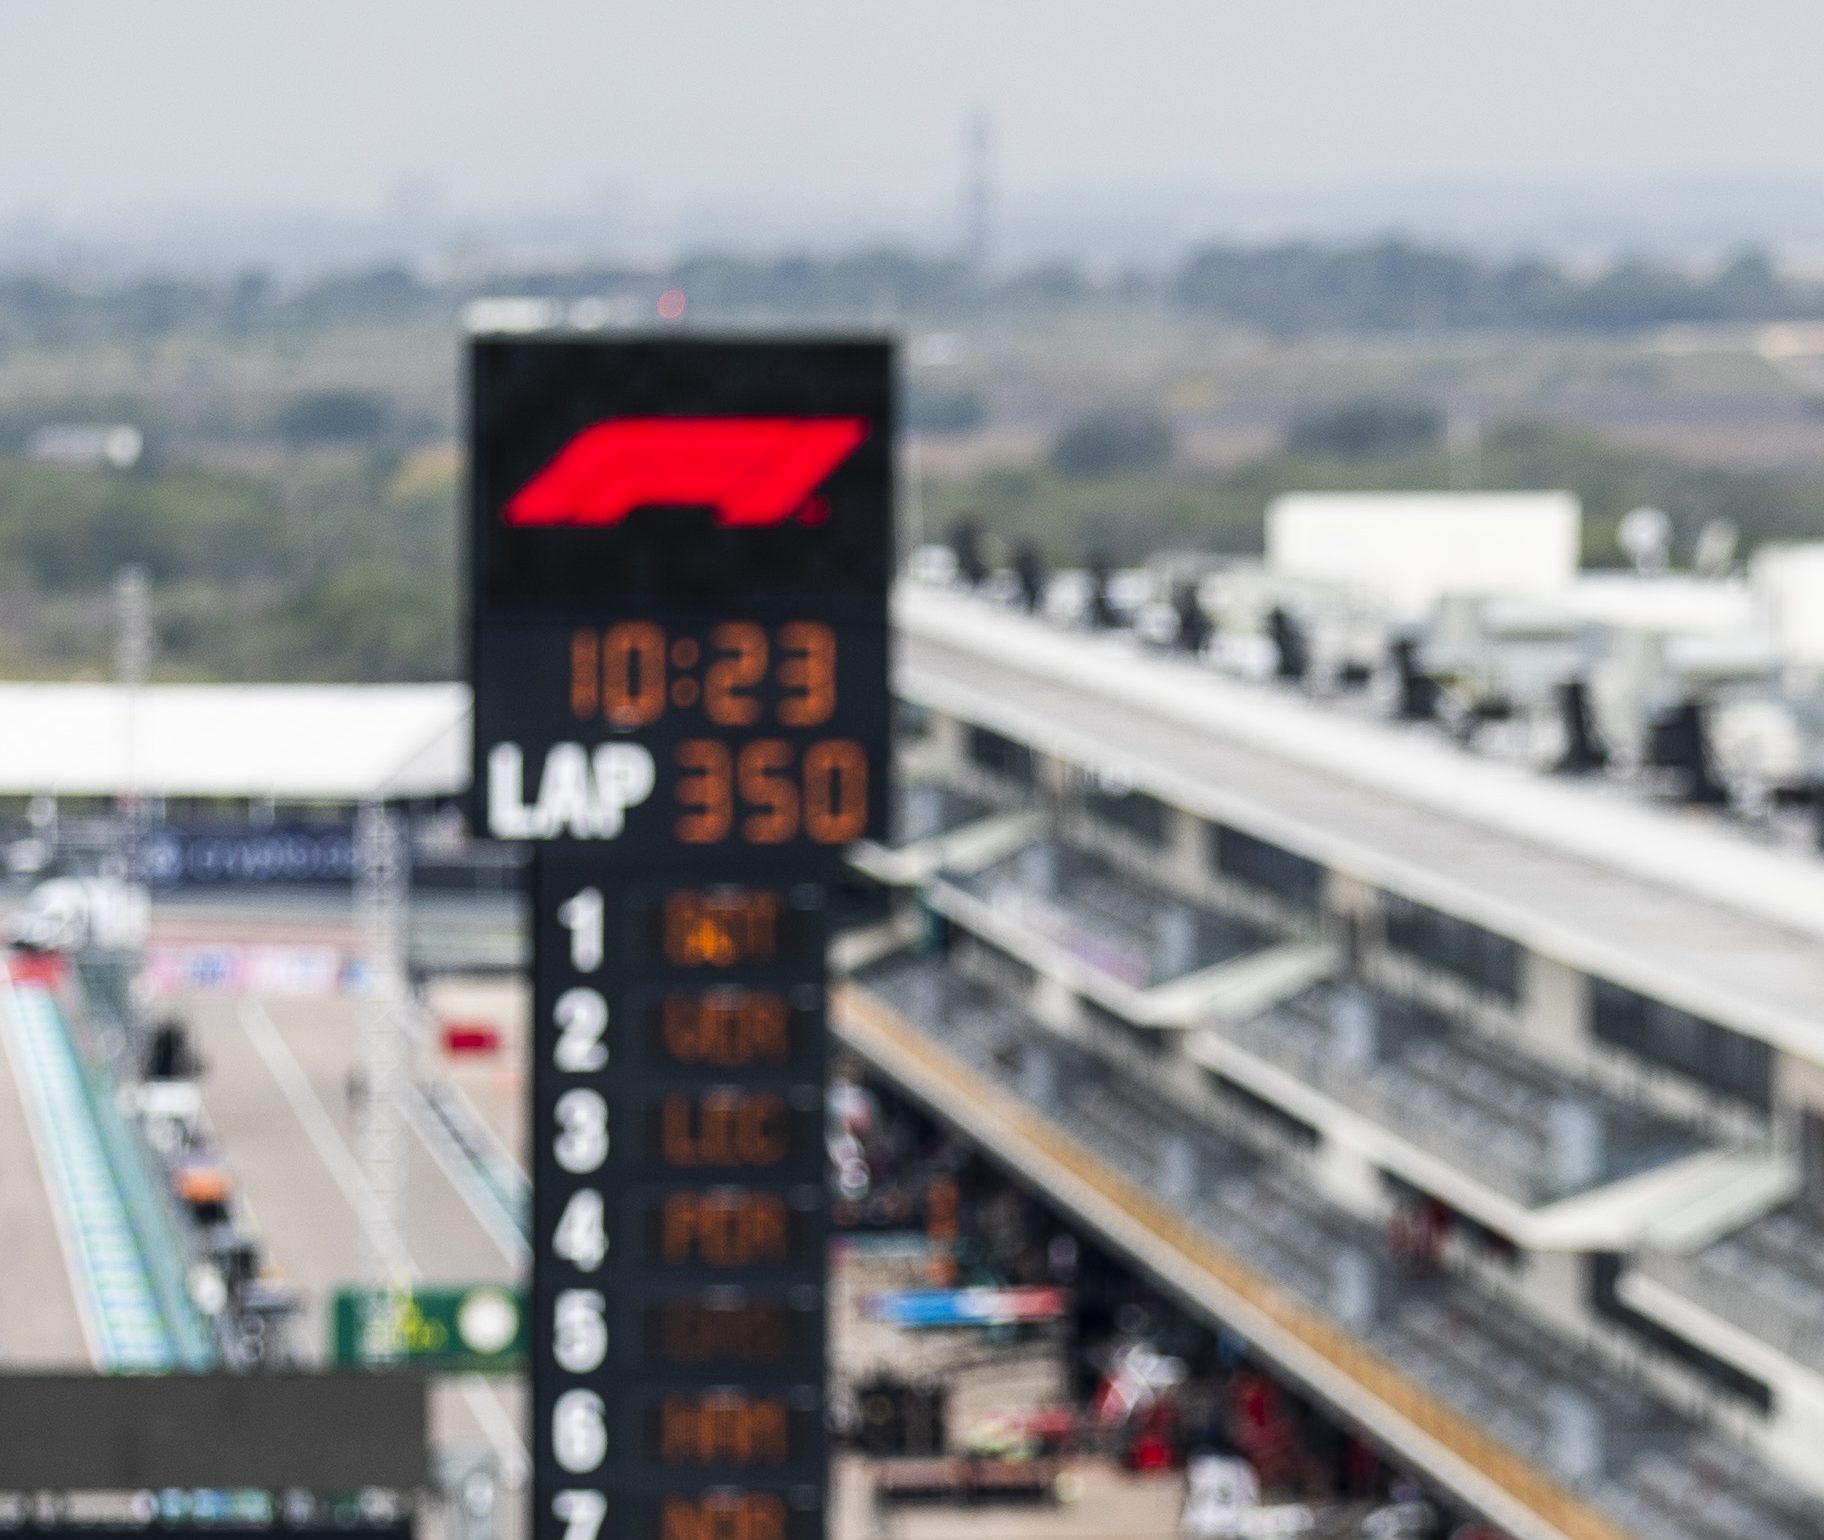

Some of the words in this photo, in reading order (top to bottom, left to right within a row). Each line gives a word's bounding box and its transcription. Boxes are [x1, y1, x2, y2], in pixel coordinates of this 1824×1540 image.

[570, 620, 838, 728] 10:23
[487, 742, 656, 840] LAP
[672, 738, 868, 845] 350
[558, 887, 606, 973] 1
[553, 987, 609, 1073] 2
[553, 1088, 609, 1174] 3
[552, 1188, 609, 1272] 4
[553, 1289, 608, 1375] 5
[552, 1388, 608, 1474] 6
